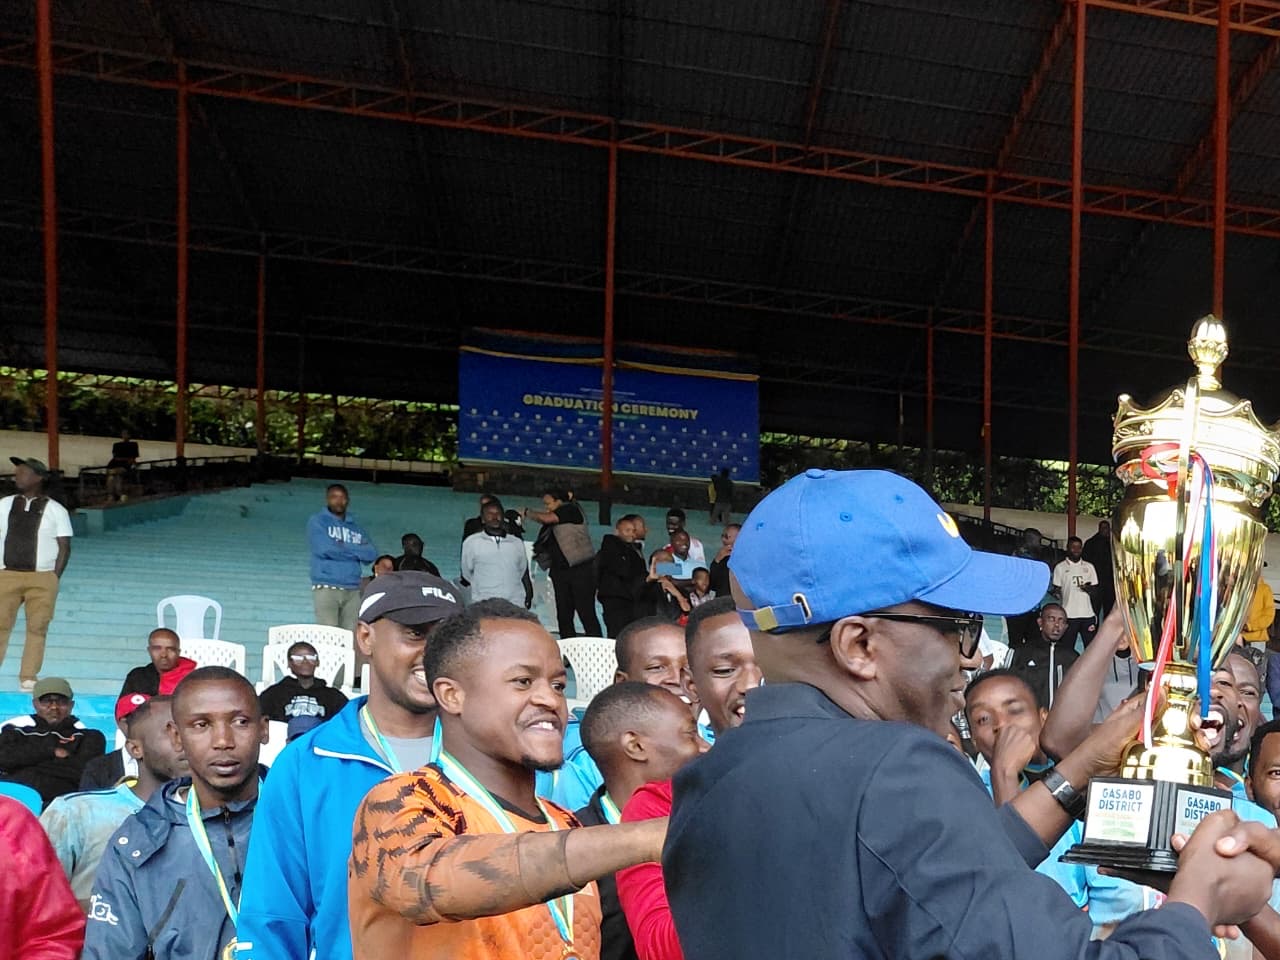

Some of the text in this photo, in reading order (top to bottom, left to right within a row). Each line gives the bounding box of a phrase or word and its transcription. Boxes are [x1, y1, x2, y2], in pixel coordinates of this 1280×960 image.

[620, 402, 699, 420] CEREMONY
[421, 586, 457, 604] FILA
[1102, 788, 1142, 801] GASABO
[1098, 799, 1143, 812] DISTRICT
[1187, 797, 1222, 812] GASABO
